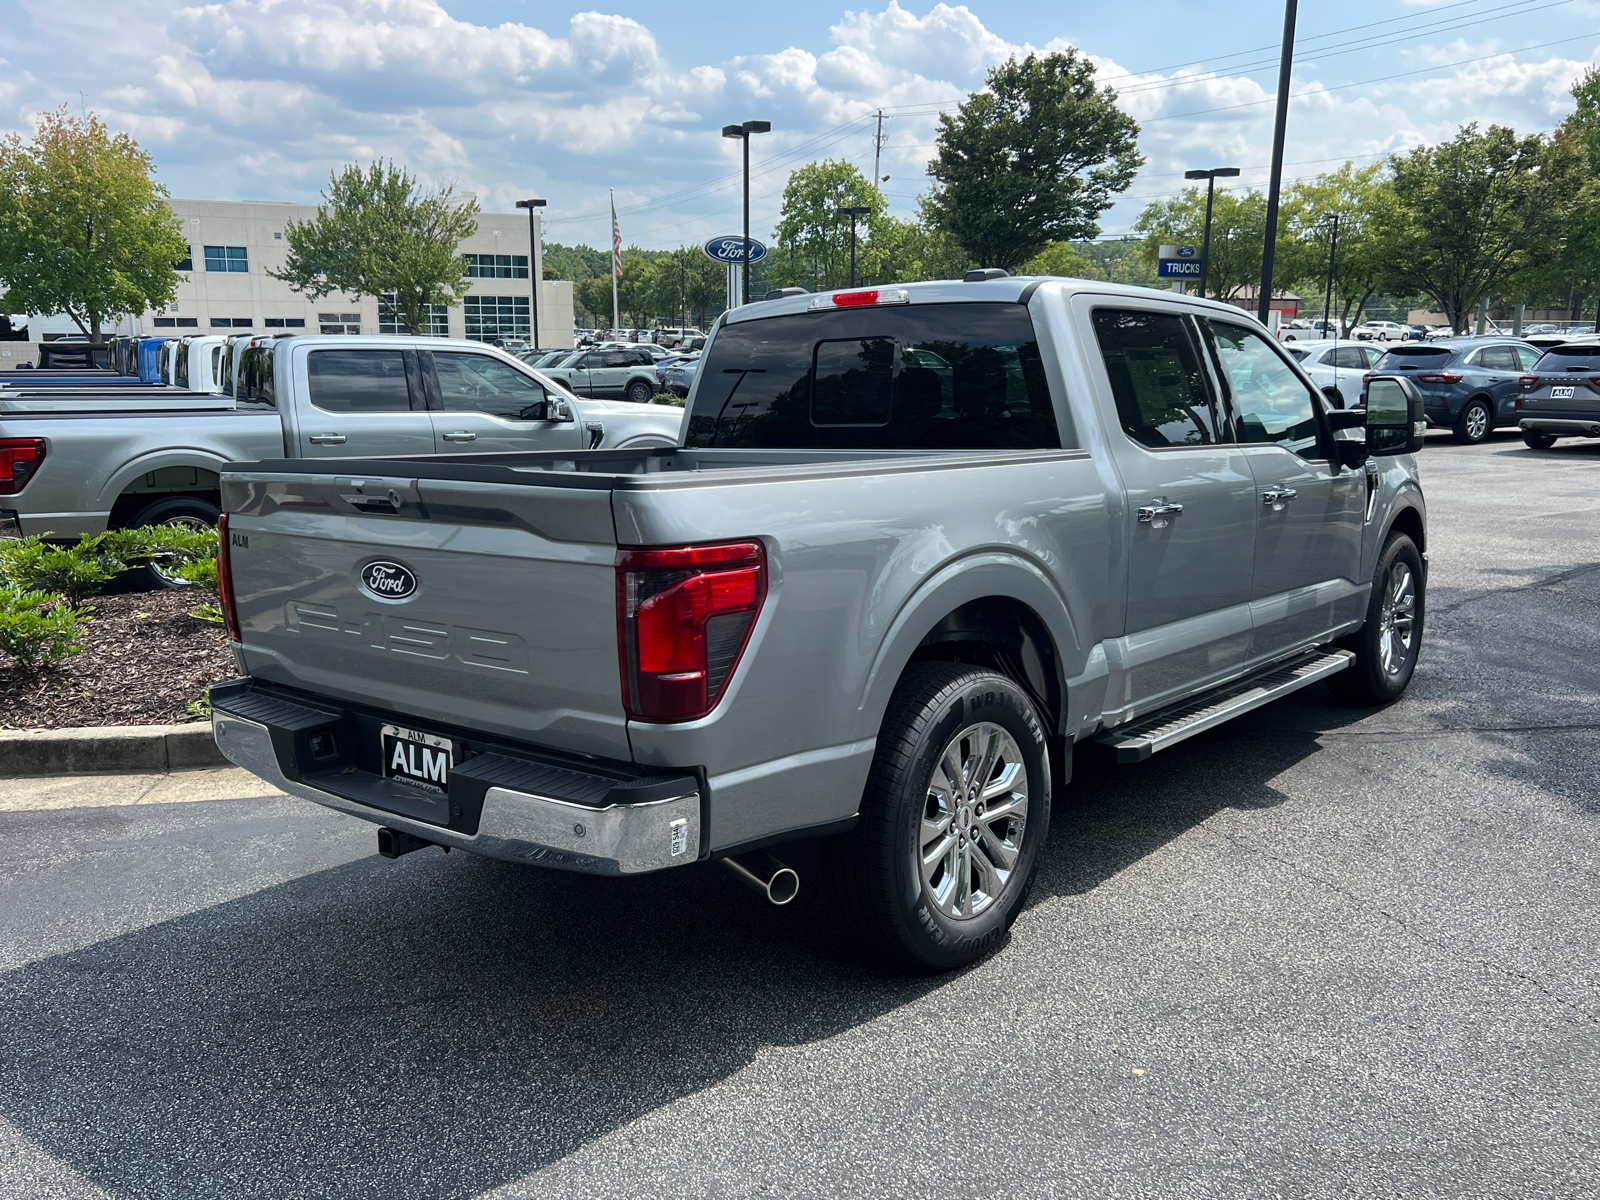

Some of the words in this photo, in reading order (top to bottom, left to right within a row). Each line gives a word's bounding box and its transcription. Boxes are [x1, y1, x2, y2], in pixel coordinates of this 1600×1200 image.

[1166, 262, 1200, 274] TRUCKS
[1553, 388, 1572, 397] ALM
[231, 532, 249, 549] ALM
[369, 564, 405, 593] Ford
[969, 690, 1043, 746] WRANGLER
[407, 730, 426, 744] ALM
[390, 739, 447, 785] ALM
